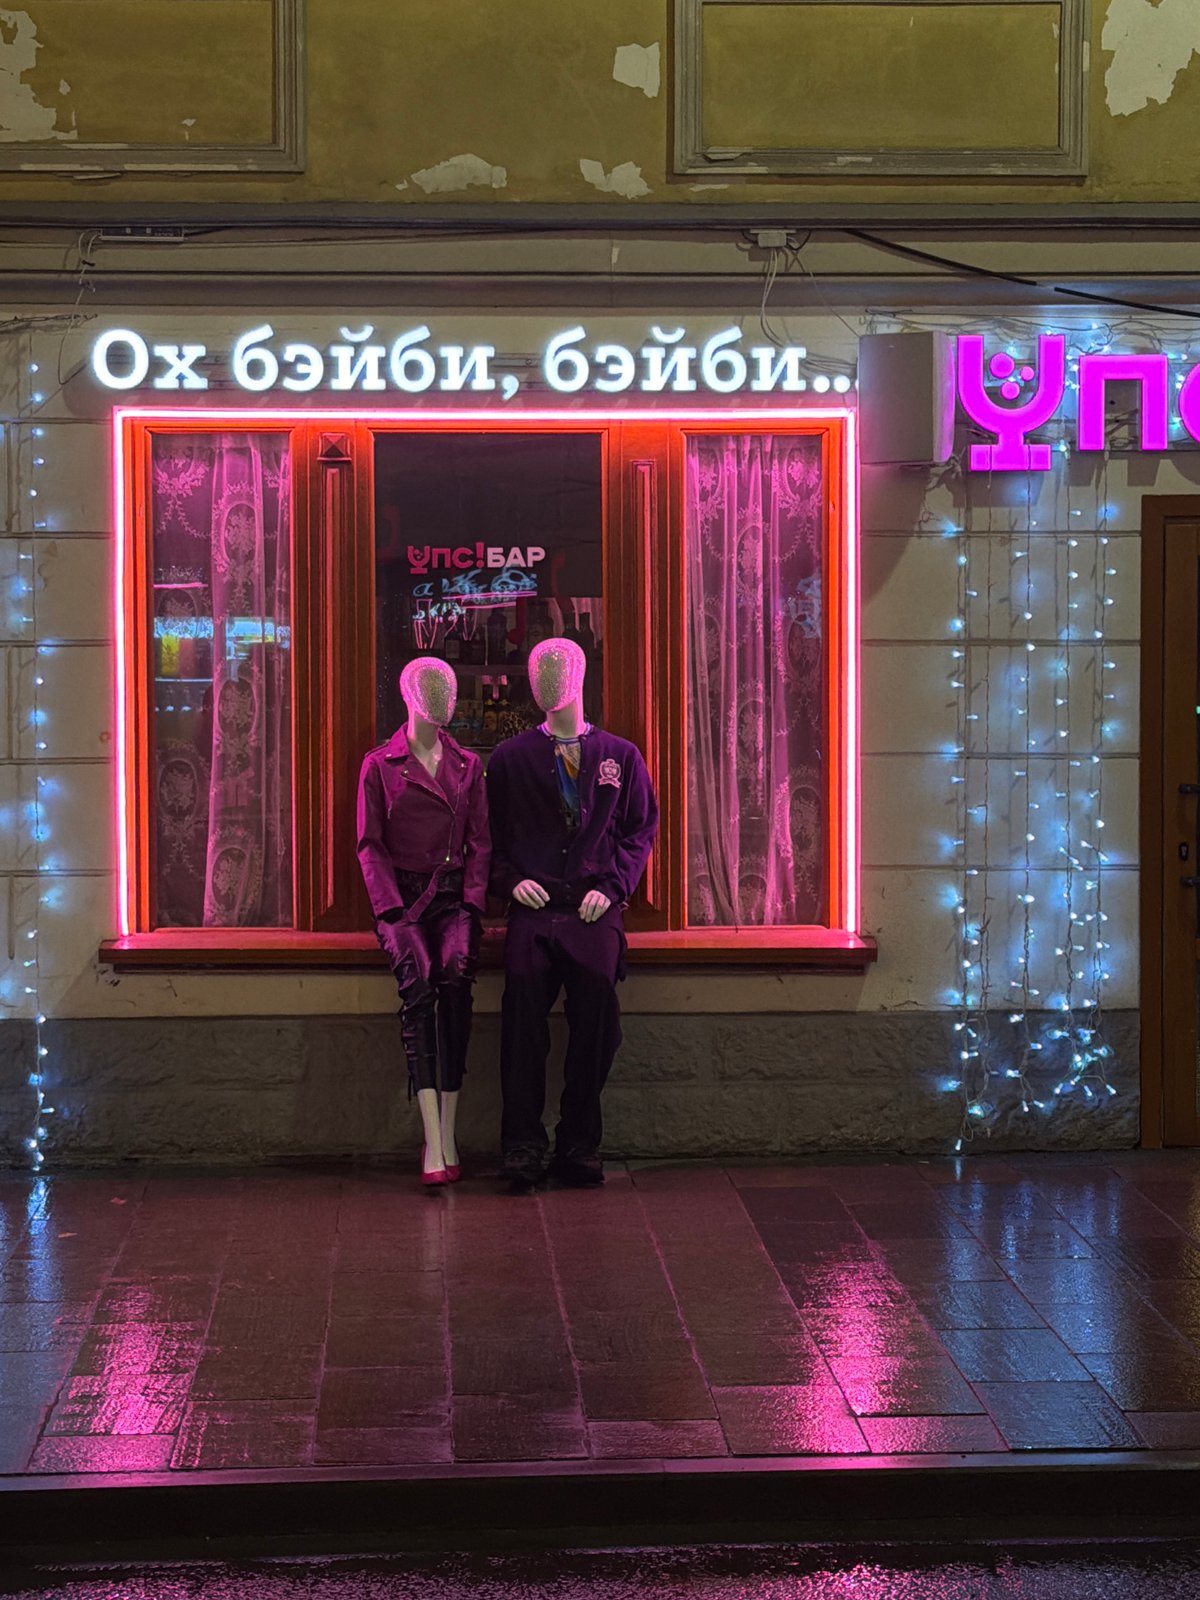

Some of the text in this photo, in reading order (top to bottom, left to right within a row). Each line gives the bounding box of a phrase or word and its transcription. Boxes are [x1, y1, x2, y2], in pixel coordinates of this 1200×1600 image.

[91, 324, 859, 400] Ох бэйби, бэйби..
[957, 334, 1200, 471] УП
